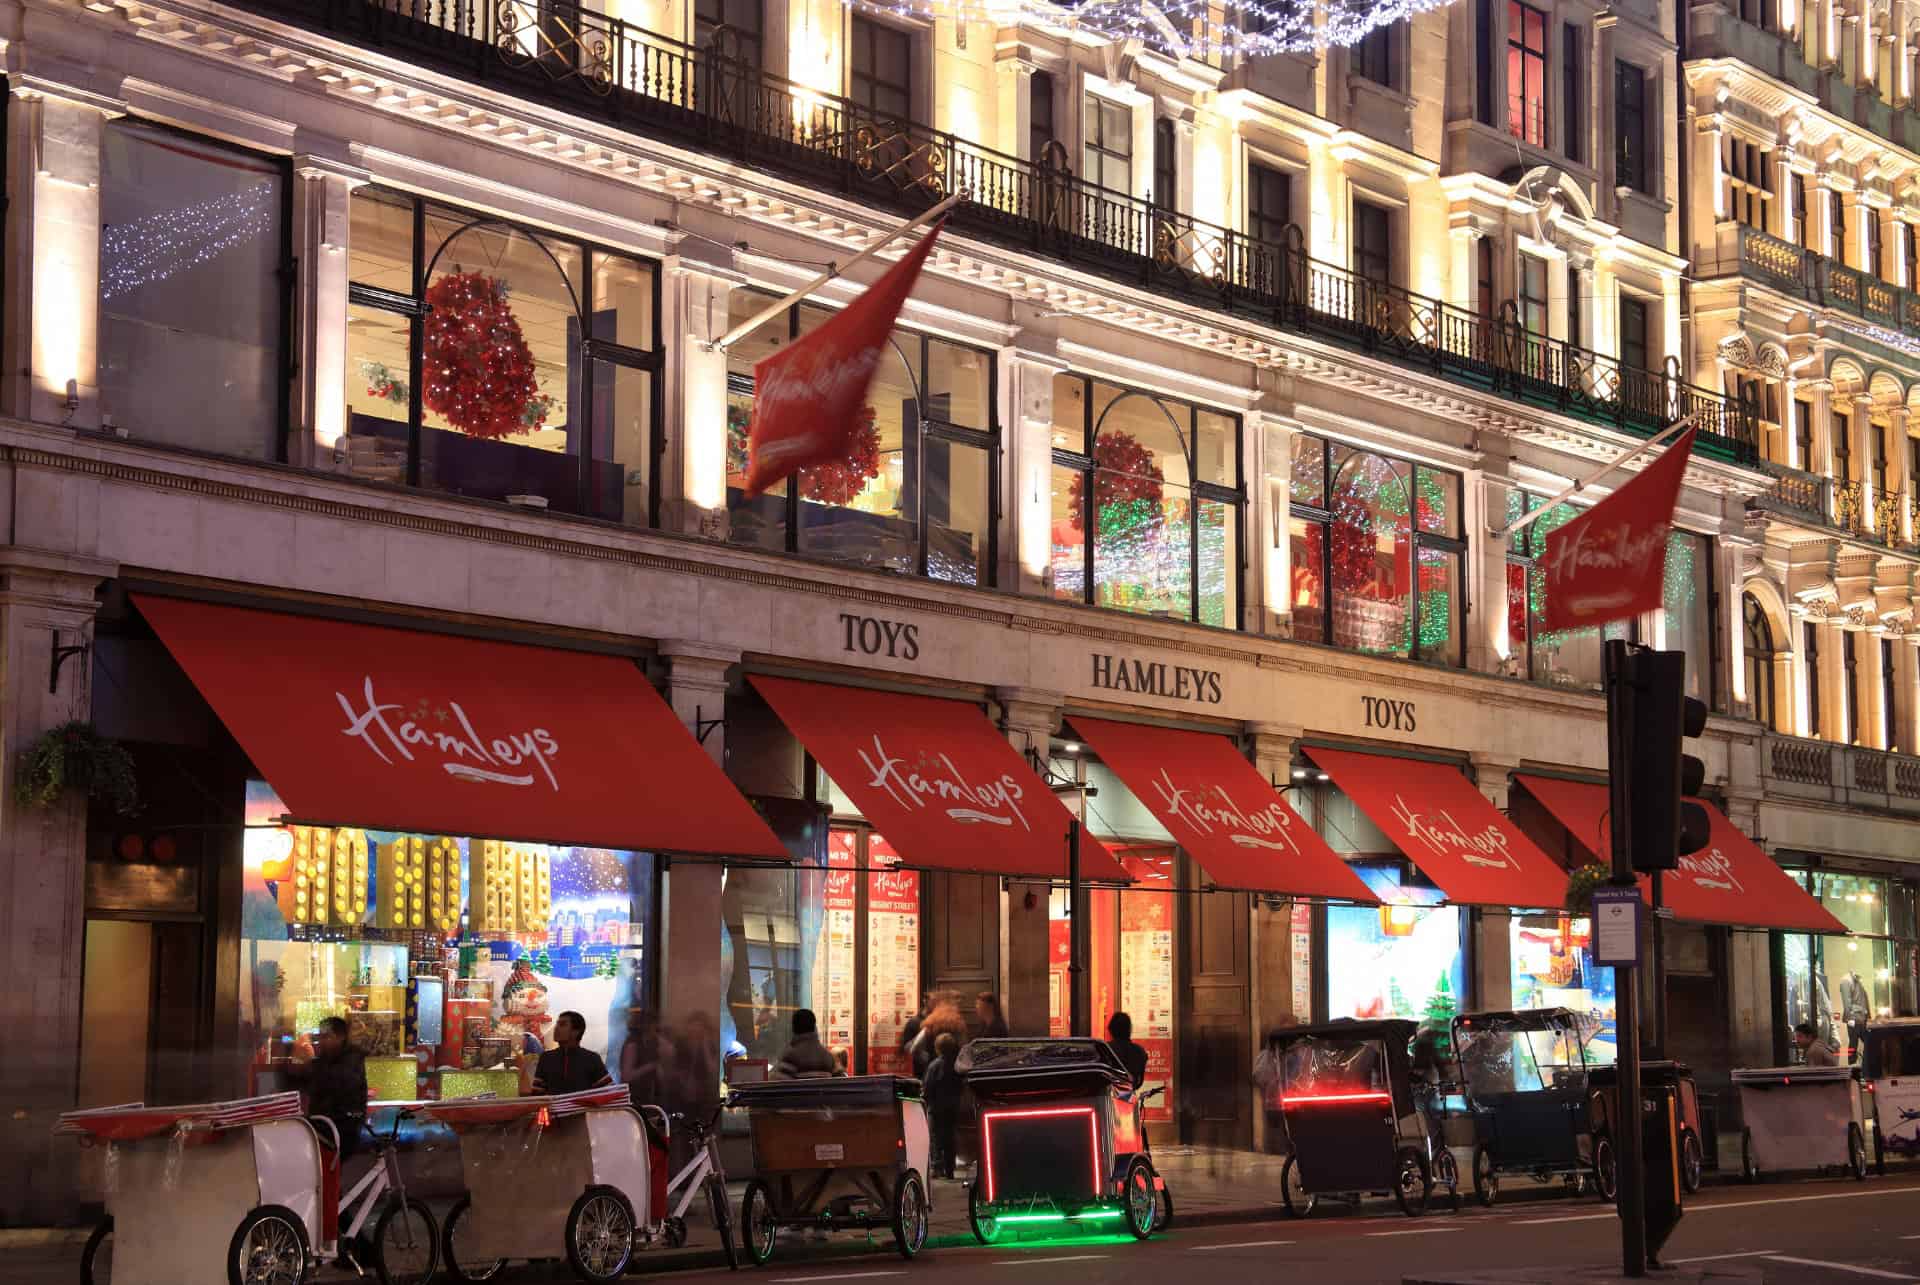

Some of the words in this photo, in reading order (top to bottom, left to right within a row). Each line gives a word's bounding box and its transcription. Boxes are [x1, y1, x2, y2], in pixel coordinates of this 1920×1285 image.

[1550, 520, 1667, 585] Hamleys
[840, 613, 919, 661] TOYS
[1091, 653, 1222, 704] HAMLEYS
[1361, 695, 1417, 733] TOYS
[336, 675, 559, 791] Hamleys
[857, 733, 1031, 832] Hamleys
[1152, 767, 1301, 857] Hamleys
[1390, 793, 1522, 873] Hamleys
[292, 825, 369, 925] HO
[390, 836, 461, 930] HO
